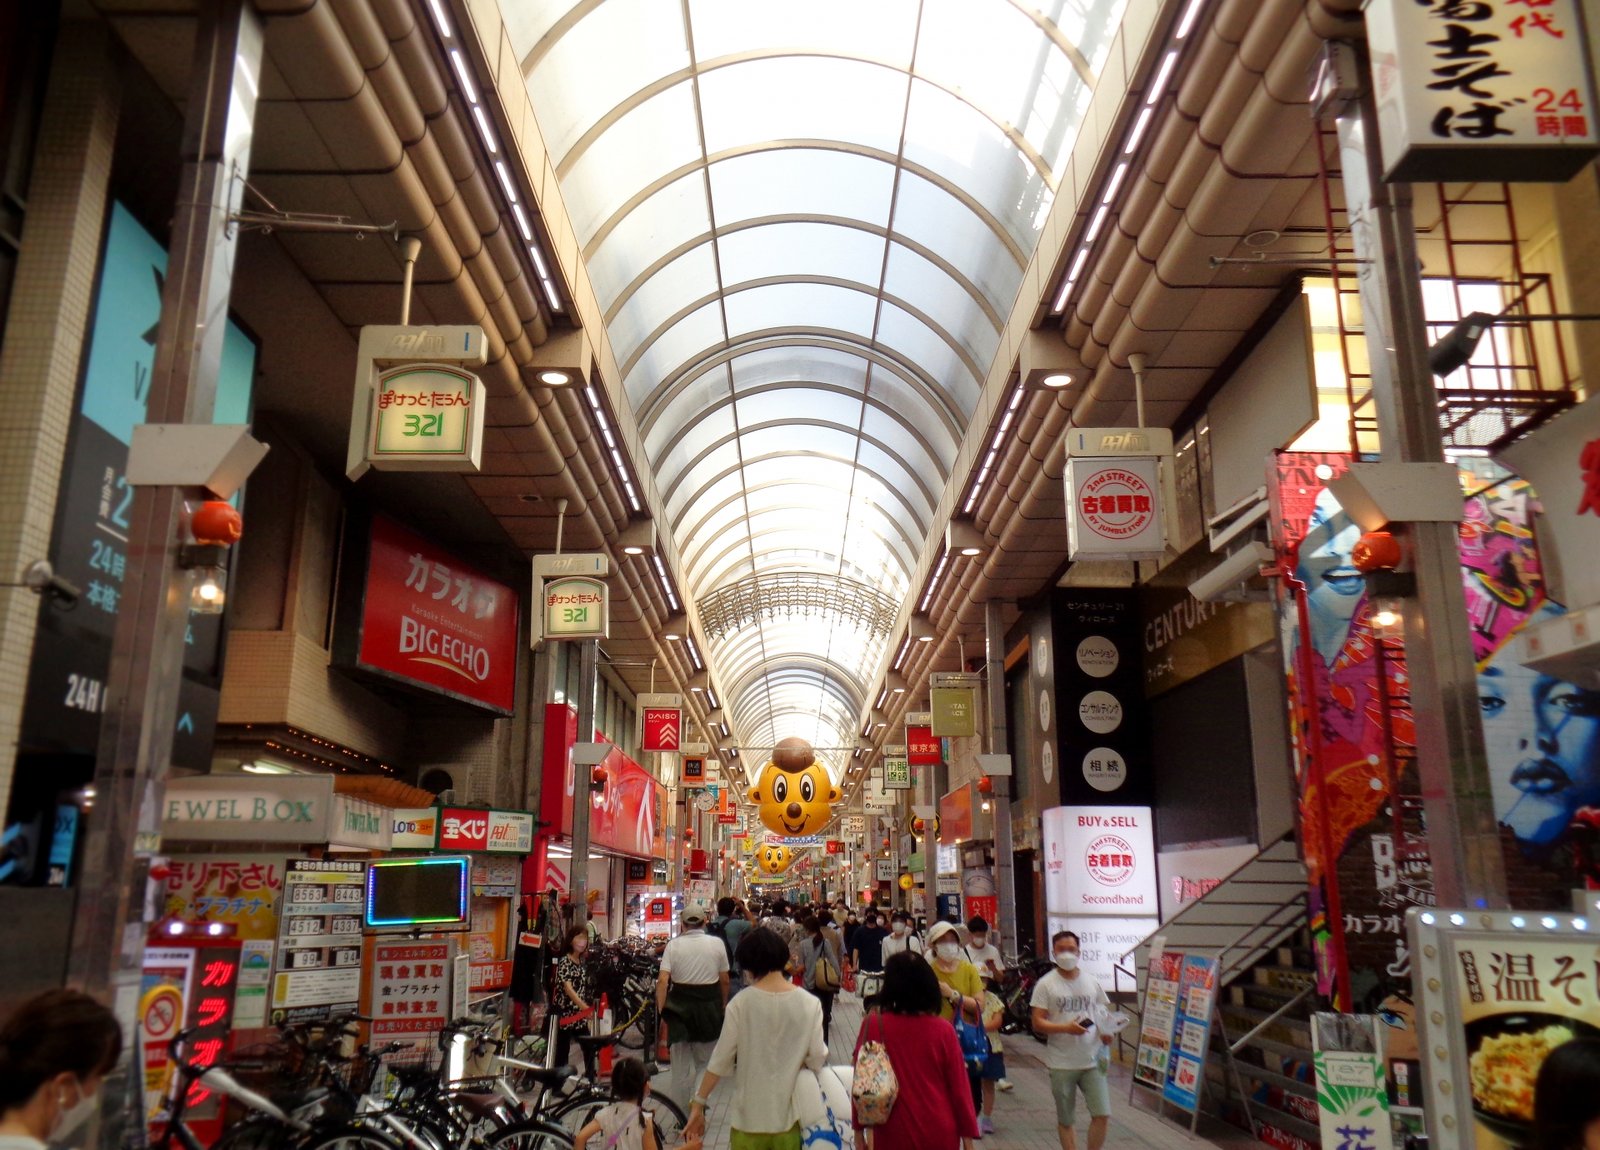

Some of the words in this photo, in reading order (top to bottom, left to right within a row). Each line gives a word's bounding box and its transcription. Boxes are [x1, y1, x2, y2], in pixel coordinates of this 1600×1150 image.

[1505, 0, 1564, 39] 代
[1532, 88, 1583, 113] 24
[1536, 115, 1588, 137] 時間
[402, 412, 443, 437] 321
[1087, 474, 1105, 492] 2nd
[1106, 472, 1145, 492] STREET
[1082, 495, 1151, 514] 古着買取
[1088, 515, 1099, 526] BY
[1098, 523, 1128, 535] JUMBLE
[89, 539, 127, 583] 24時
[405, 552, 497, 620] カラオケ
[86, 579, 121, 615] 本格
[411, 602, 439, 624] Karaoke
[440, 616, 484, 643] Entertainment
[562, 607, 588, 623] 321
[399, 615, 439, 654] BIG
[441, 636, 490, 681] ECHO
[65, 674, 107, 713] 24H
[910, 743, 938, 753] 東京堂
[1089, 759, 1119, 773] 相続
[168, 799, 242, 822] EWEL
[252, 797, 314, 822] BOX
[392, 820, 416, 834] LOTO
[443, 818, 486, 840] 宝くじ
[1078, 816, 1102, 827] BUY
[1111, 816, 1138, 827] SELL
[1103, 836, 1129, 851] STREET
[1088, 854, 1133, 867] 古着買取
[294, 889, 322, 902] 8563
[334, 888, 360, 901] 8443
[1082, 894, 1144, 905] Secondhand
[290, 920, 319, 933] 4512
[1343, 913, 1406, 934] カラオ
[1081, 931, 1101, 944] B1F
[301, 953, 315, 965] 99
[343, 951, 356, 963] 94
[1082, 951, 1102, 962] B2F
[380, 964, 443, 979] 現金買取
[1489, 952, 1600, 1006] 温そ
[382, 984, 440, 996] 金・プラチナ
[382, 1001, 438, 1014] 無料査定
[376, 1018, 443, 1031] お売りください
